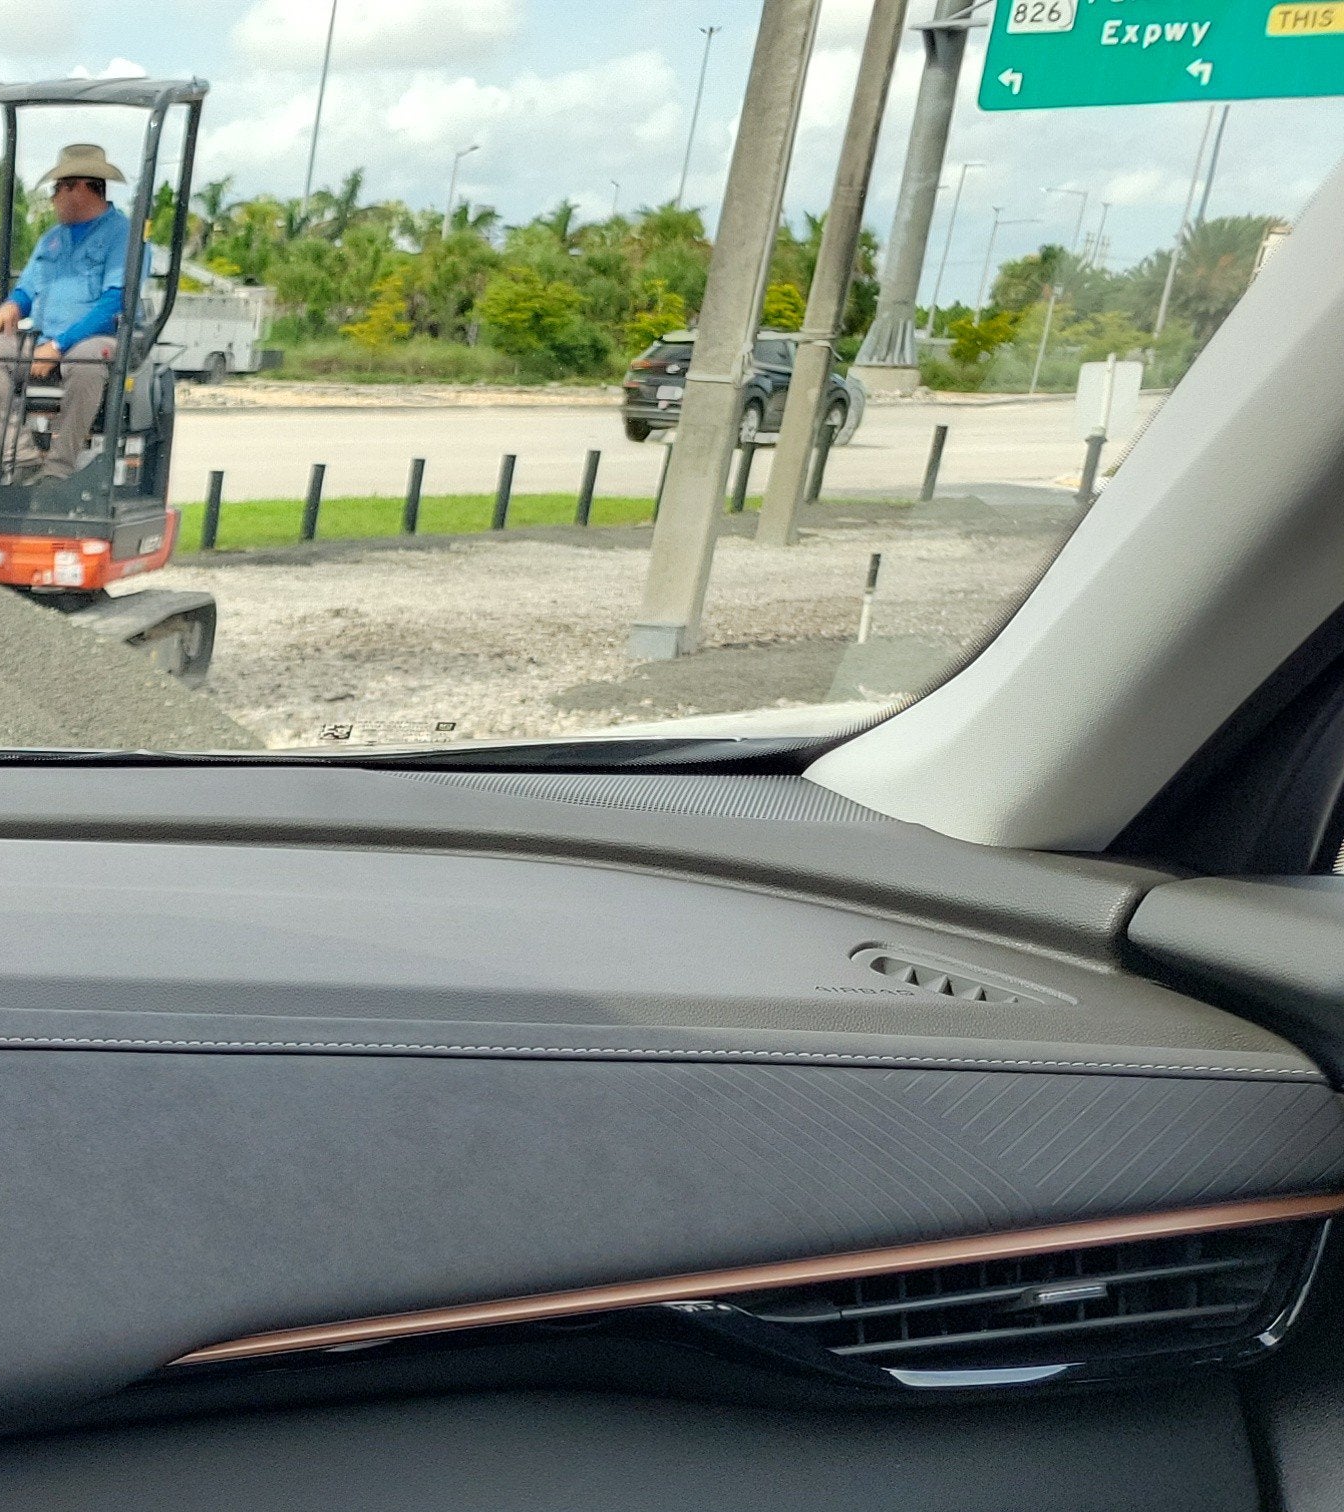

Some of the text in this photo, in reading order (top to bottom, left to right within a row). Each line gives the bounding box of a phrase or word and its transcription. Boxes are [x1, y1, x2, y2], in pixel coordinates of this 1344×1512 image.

[1012, 2, 1063, 23] 826
[1277, 8, 1334, 28] THIS
[1100, 19, 1212, 49] Expwy
